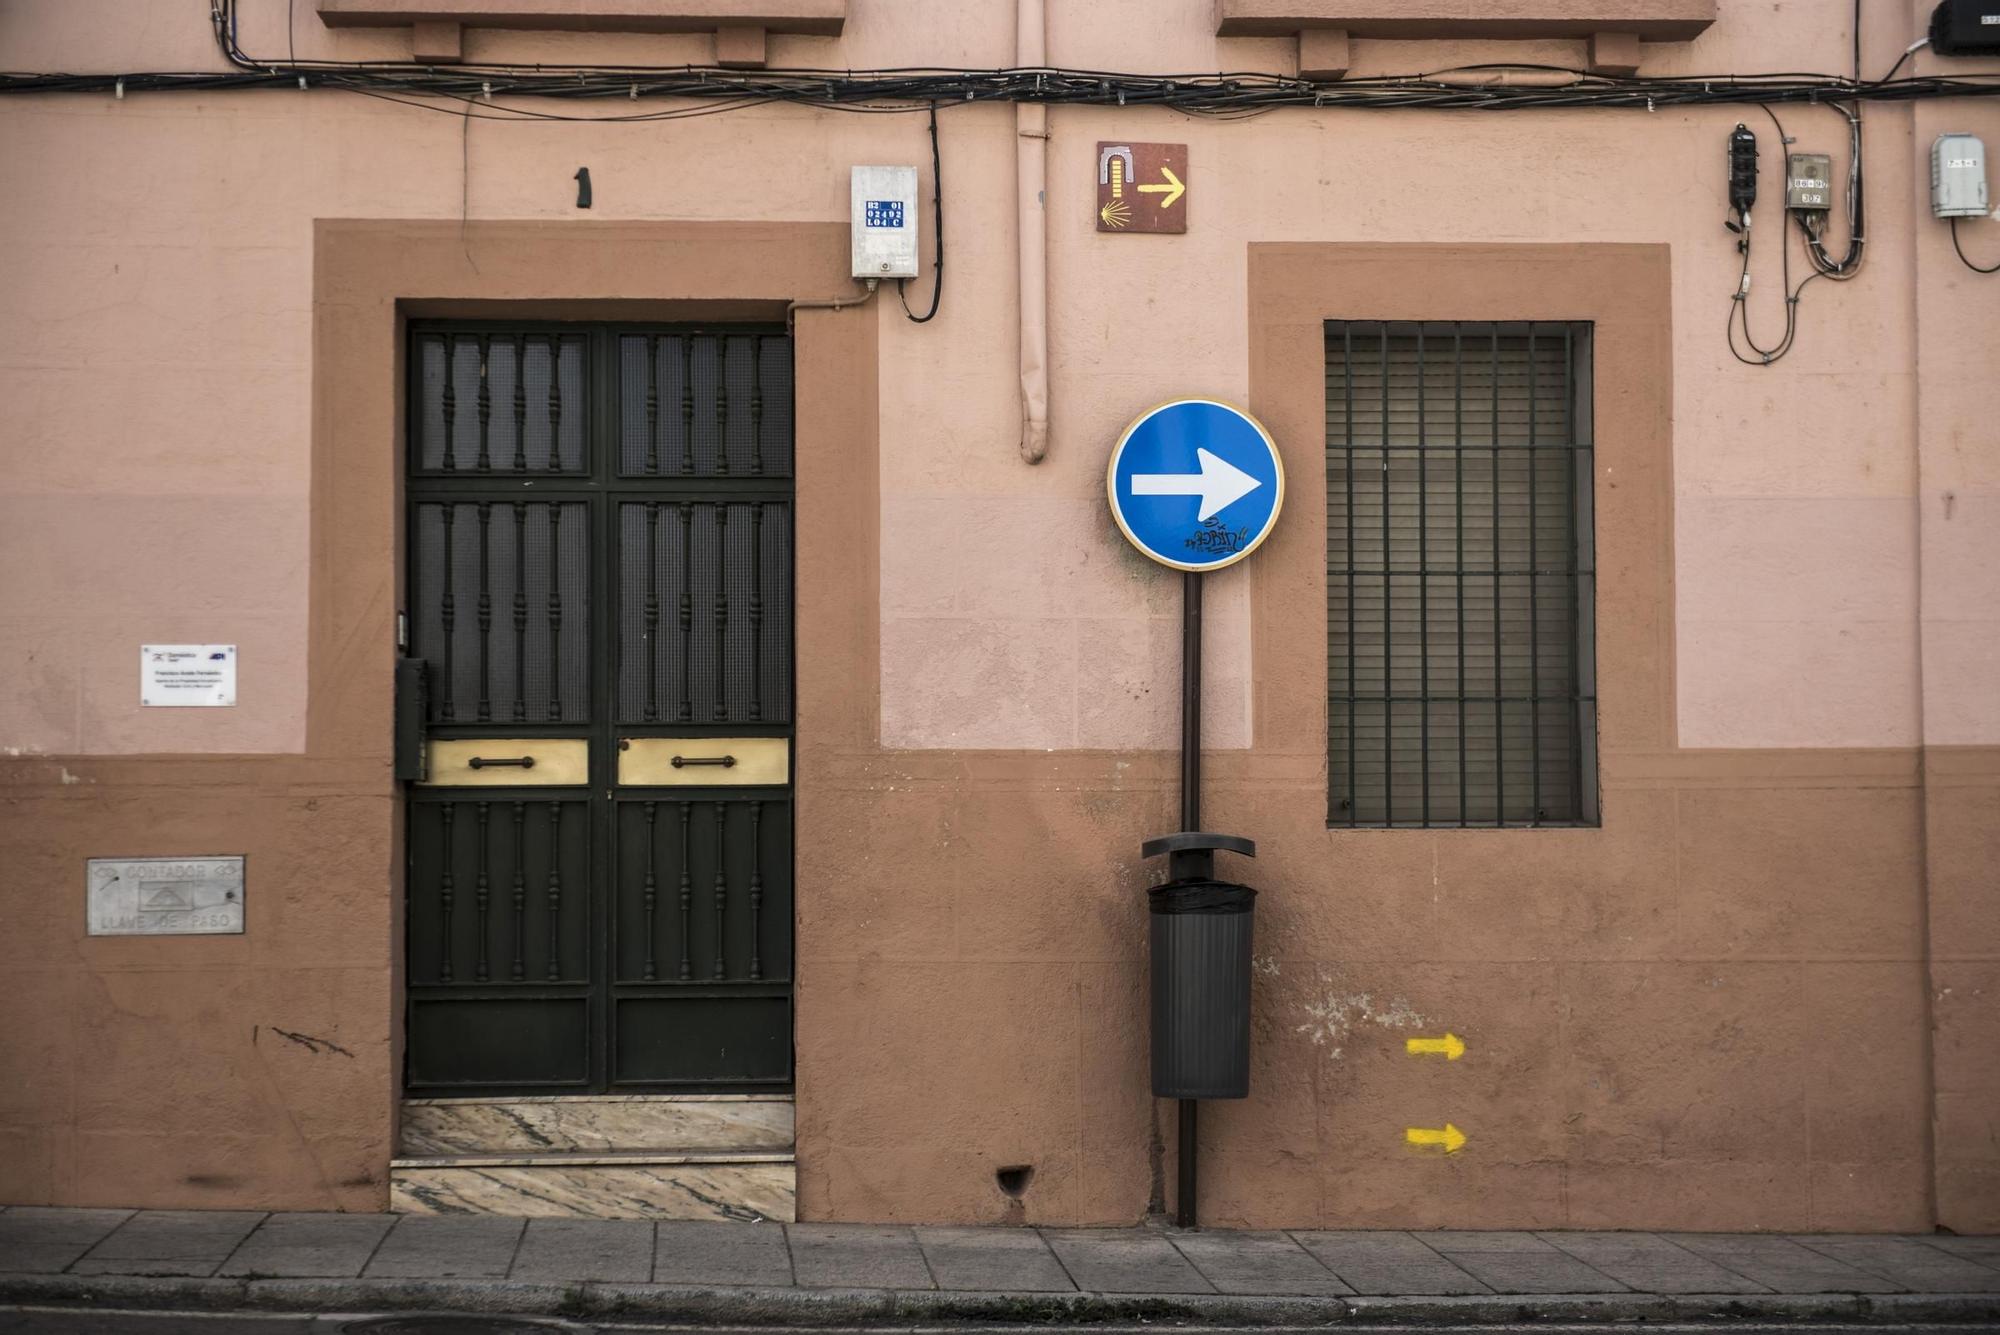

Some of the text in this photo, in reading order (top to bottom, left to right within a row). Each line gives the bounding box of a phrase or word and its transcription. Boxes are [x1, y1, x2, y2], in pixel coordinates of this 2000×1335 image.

[573, 167, 592, 209] 1
[867, 201, 879, 209] B2
[892, 218, 900, 227] C
[126, 864, 206, 880] CONTADOR
[101, 914, 146, 929] LLAVE
[191, 913, 231, 928] PASO
